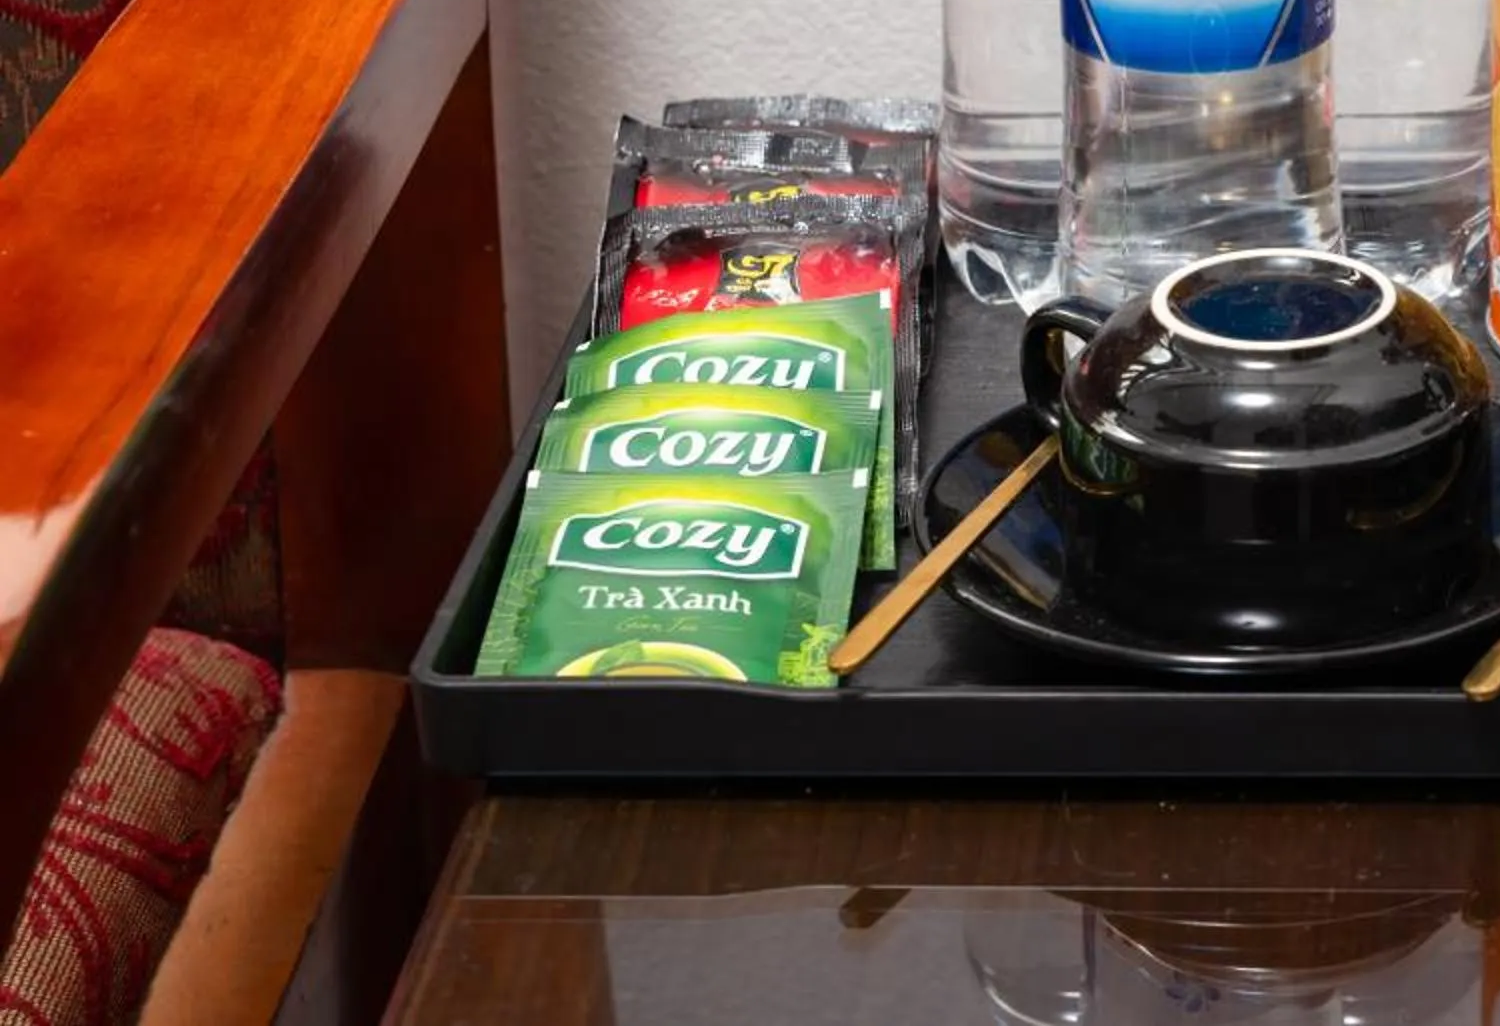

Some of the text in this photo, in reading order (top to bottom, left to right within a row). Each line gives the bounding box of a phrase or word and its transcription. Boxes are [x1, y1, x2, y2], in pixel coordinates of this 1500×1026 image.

[609, 427, 796, 476] Cozy
[583, 517, 776, 567] Cozy
[577, 585, 752, 615] Trà Xanh
